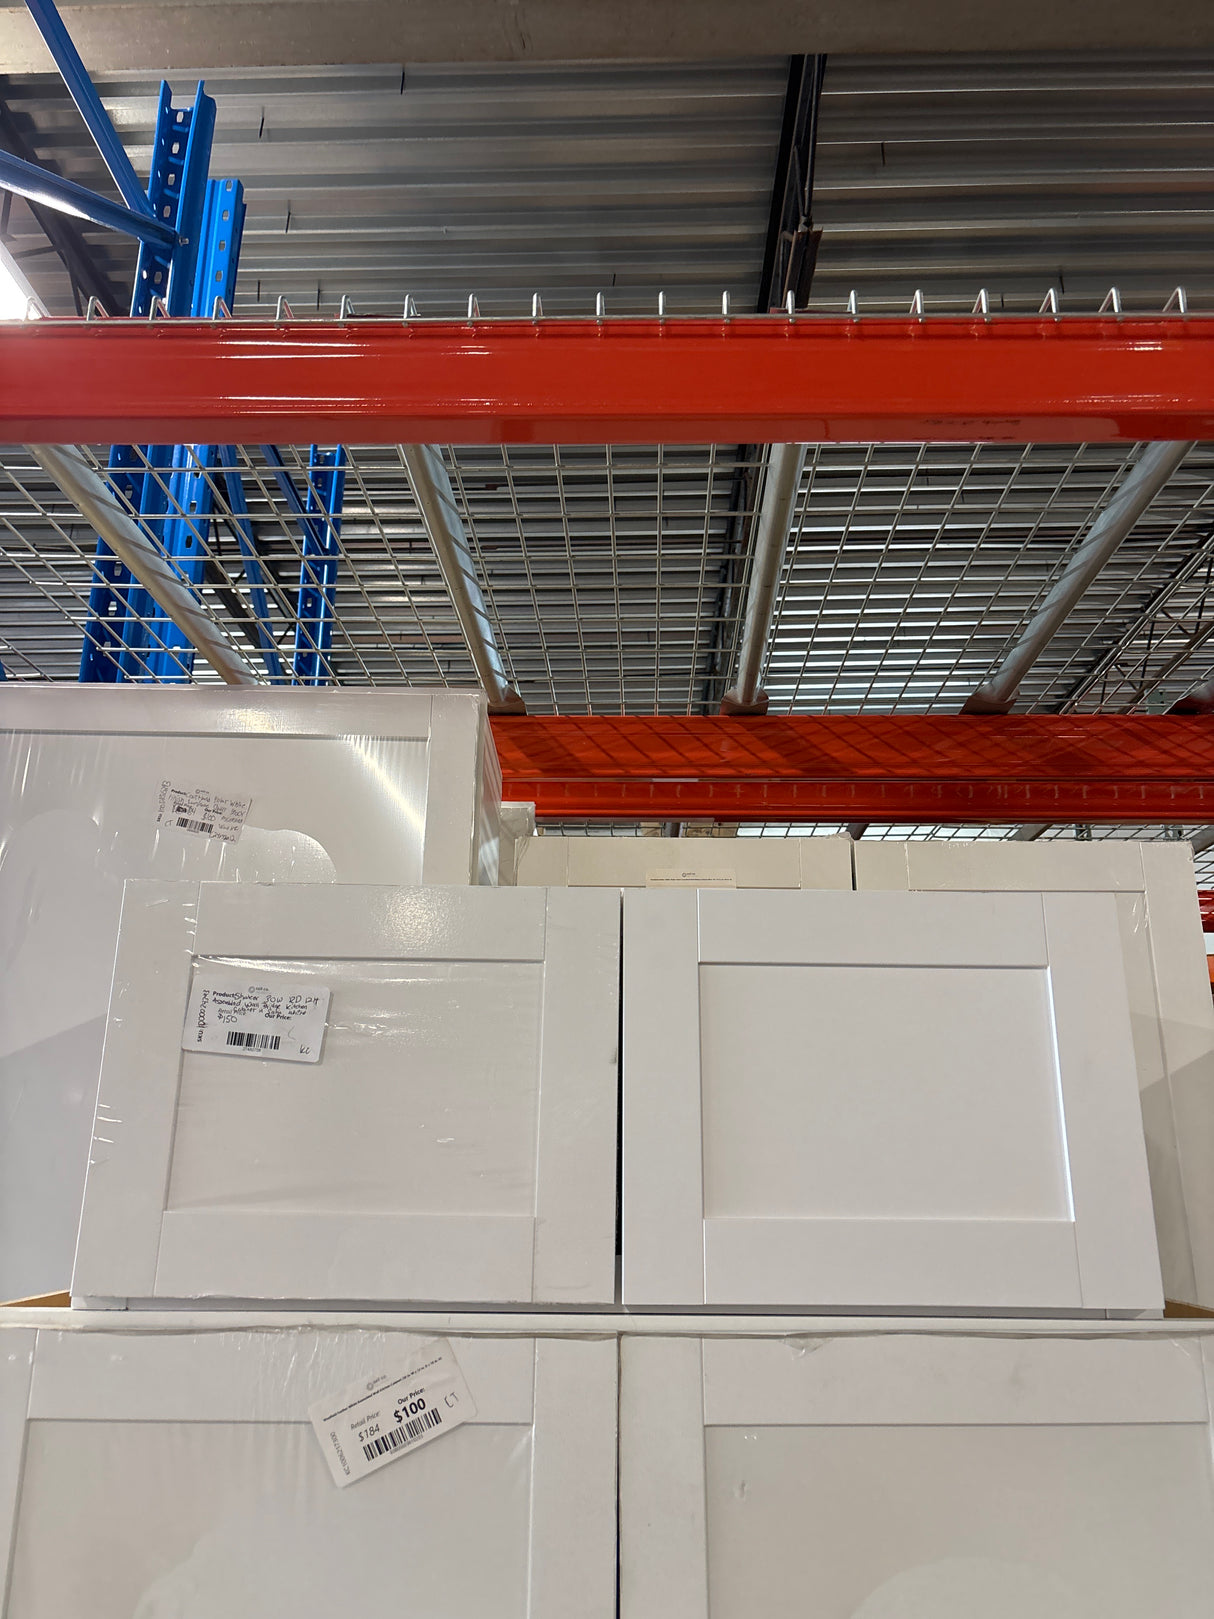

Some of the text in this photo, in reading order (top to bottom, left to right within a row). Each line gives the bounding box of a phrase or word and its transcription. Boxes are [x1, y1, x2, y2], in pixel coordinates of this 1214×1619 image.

[217, 1013, 238, 1024] $150
[264, 1012, 276, 1020] Our
[397, 1395, 409, 1405] Our
[409, 1387, 425, 1400] Price:
[393, 1398, 426, 1423] $100
[350, 1416, 366, 1430] Retail
[358, 1423, 381, 1442] $184
